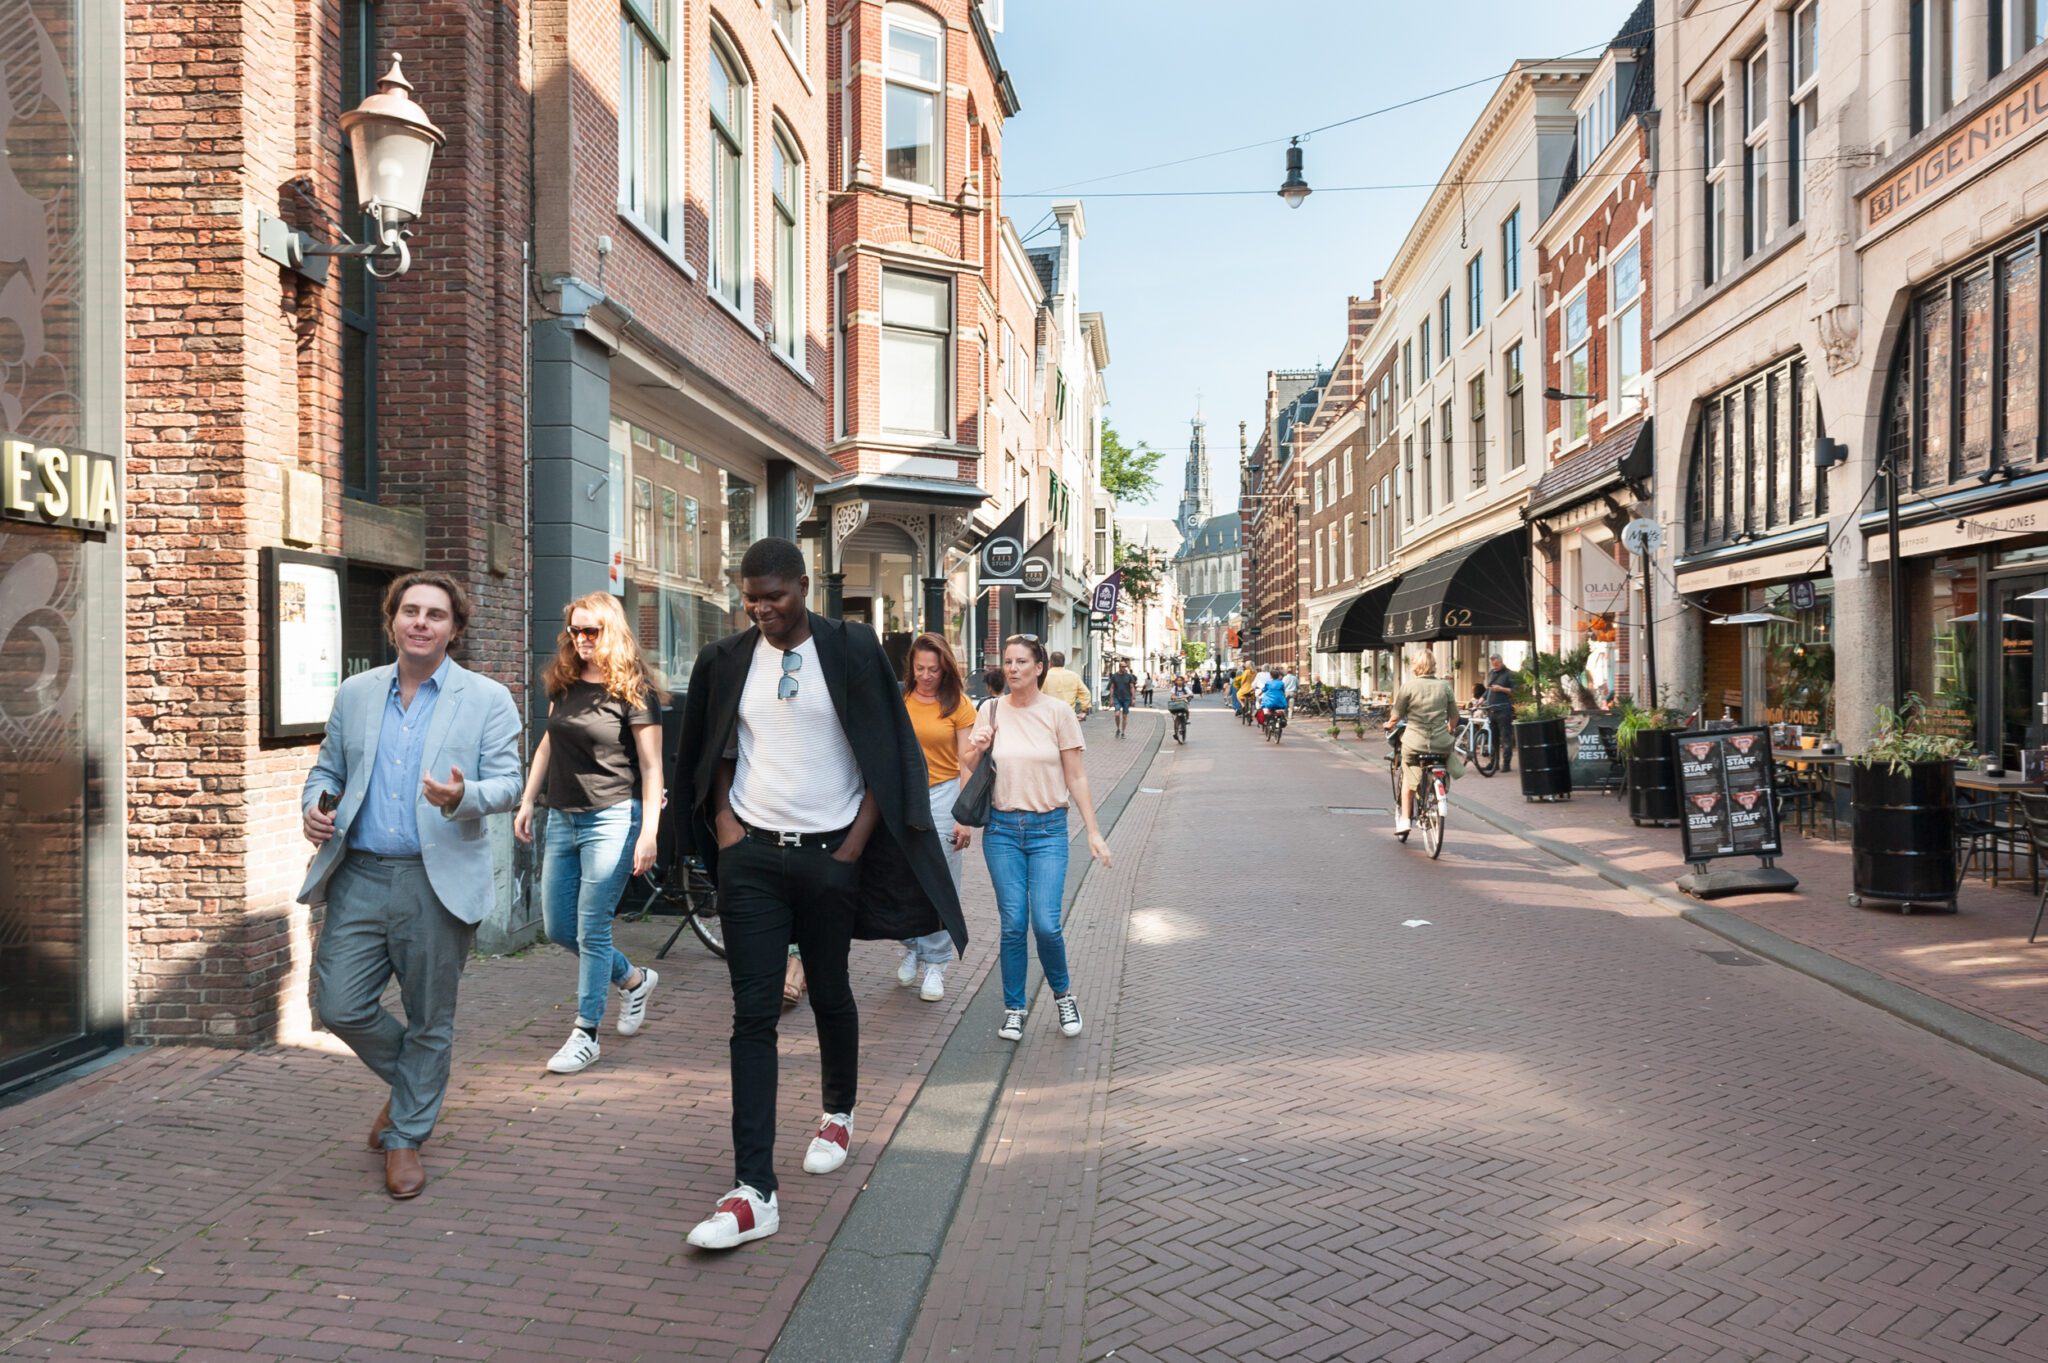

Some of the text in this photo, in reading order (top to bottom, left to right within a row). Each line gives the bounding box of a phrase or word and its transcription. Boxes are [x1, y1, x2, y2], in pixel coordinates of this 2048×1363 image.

[4, 440, 118, 524] ESIA
[2004, 514, 2036, 530] JONES
[1585, 582, 1625, 593] OLALA
[1444, 609, 1472, 627] 62
[1788, 709, 1819, 726] JONES
[1578, 734, 1600, 745] WE
[1726, 756, 1756, 766] STAFF
[1683, 763, 1713, 773] STAFF
[1689, 815, 1718, 825] STAFF
[1731, 812, 1761, 823] STAFF
